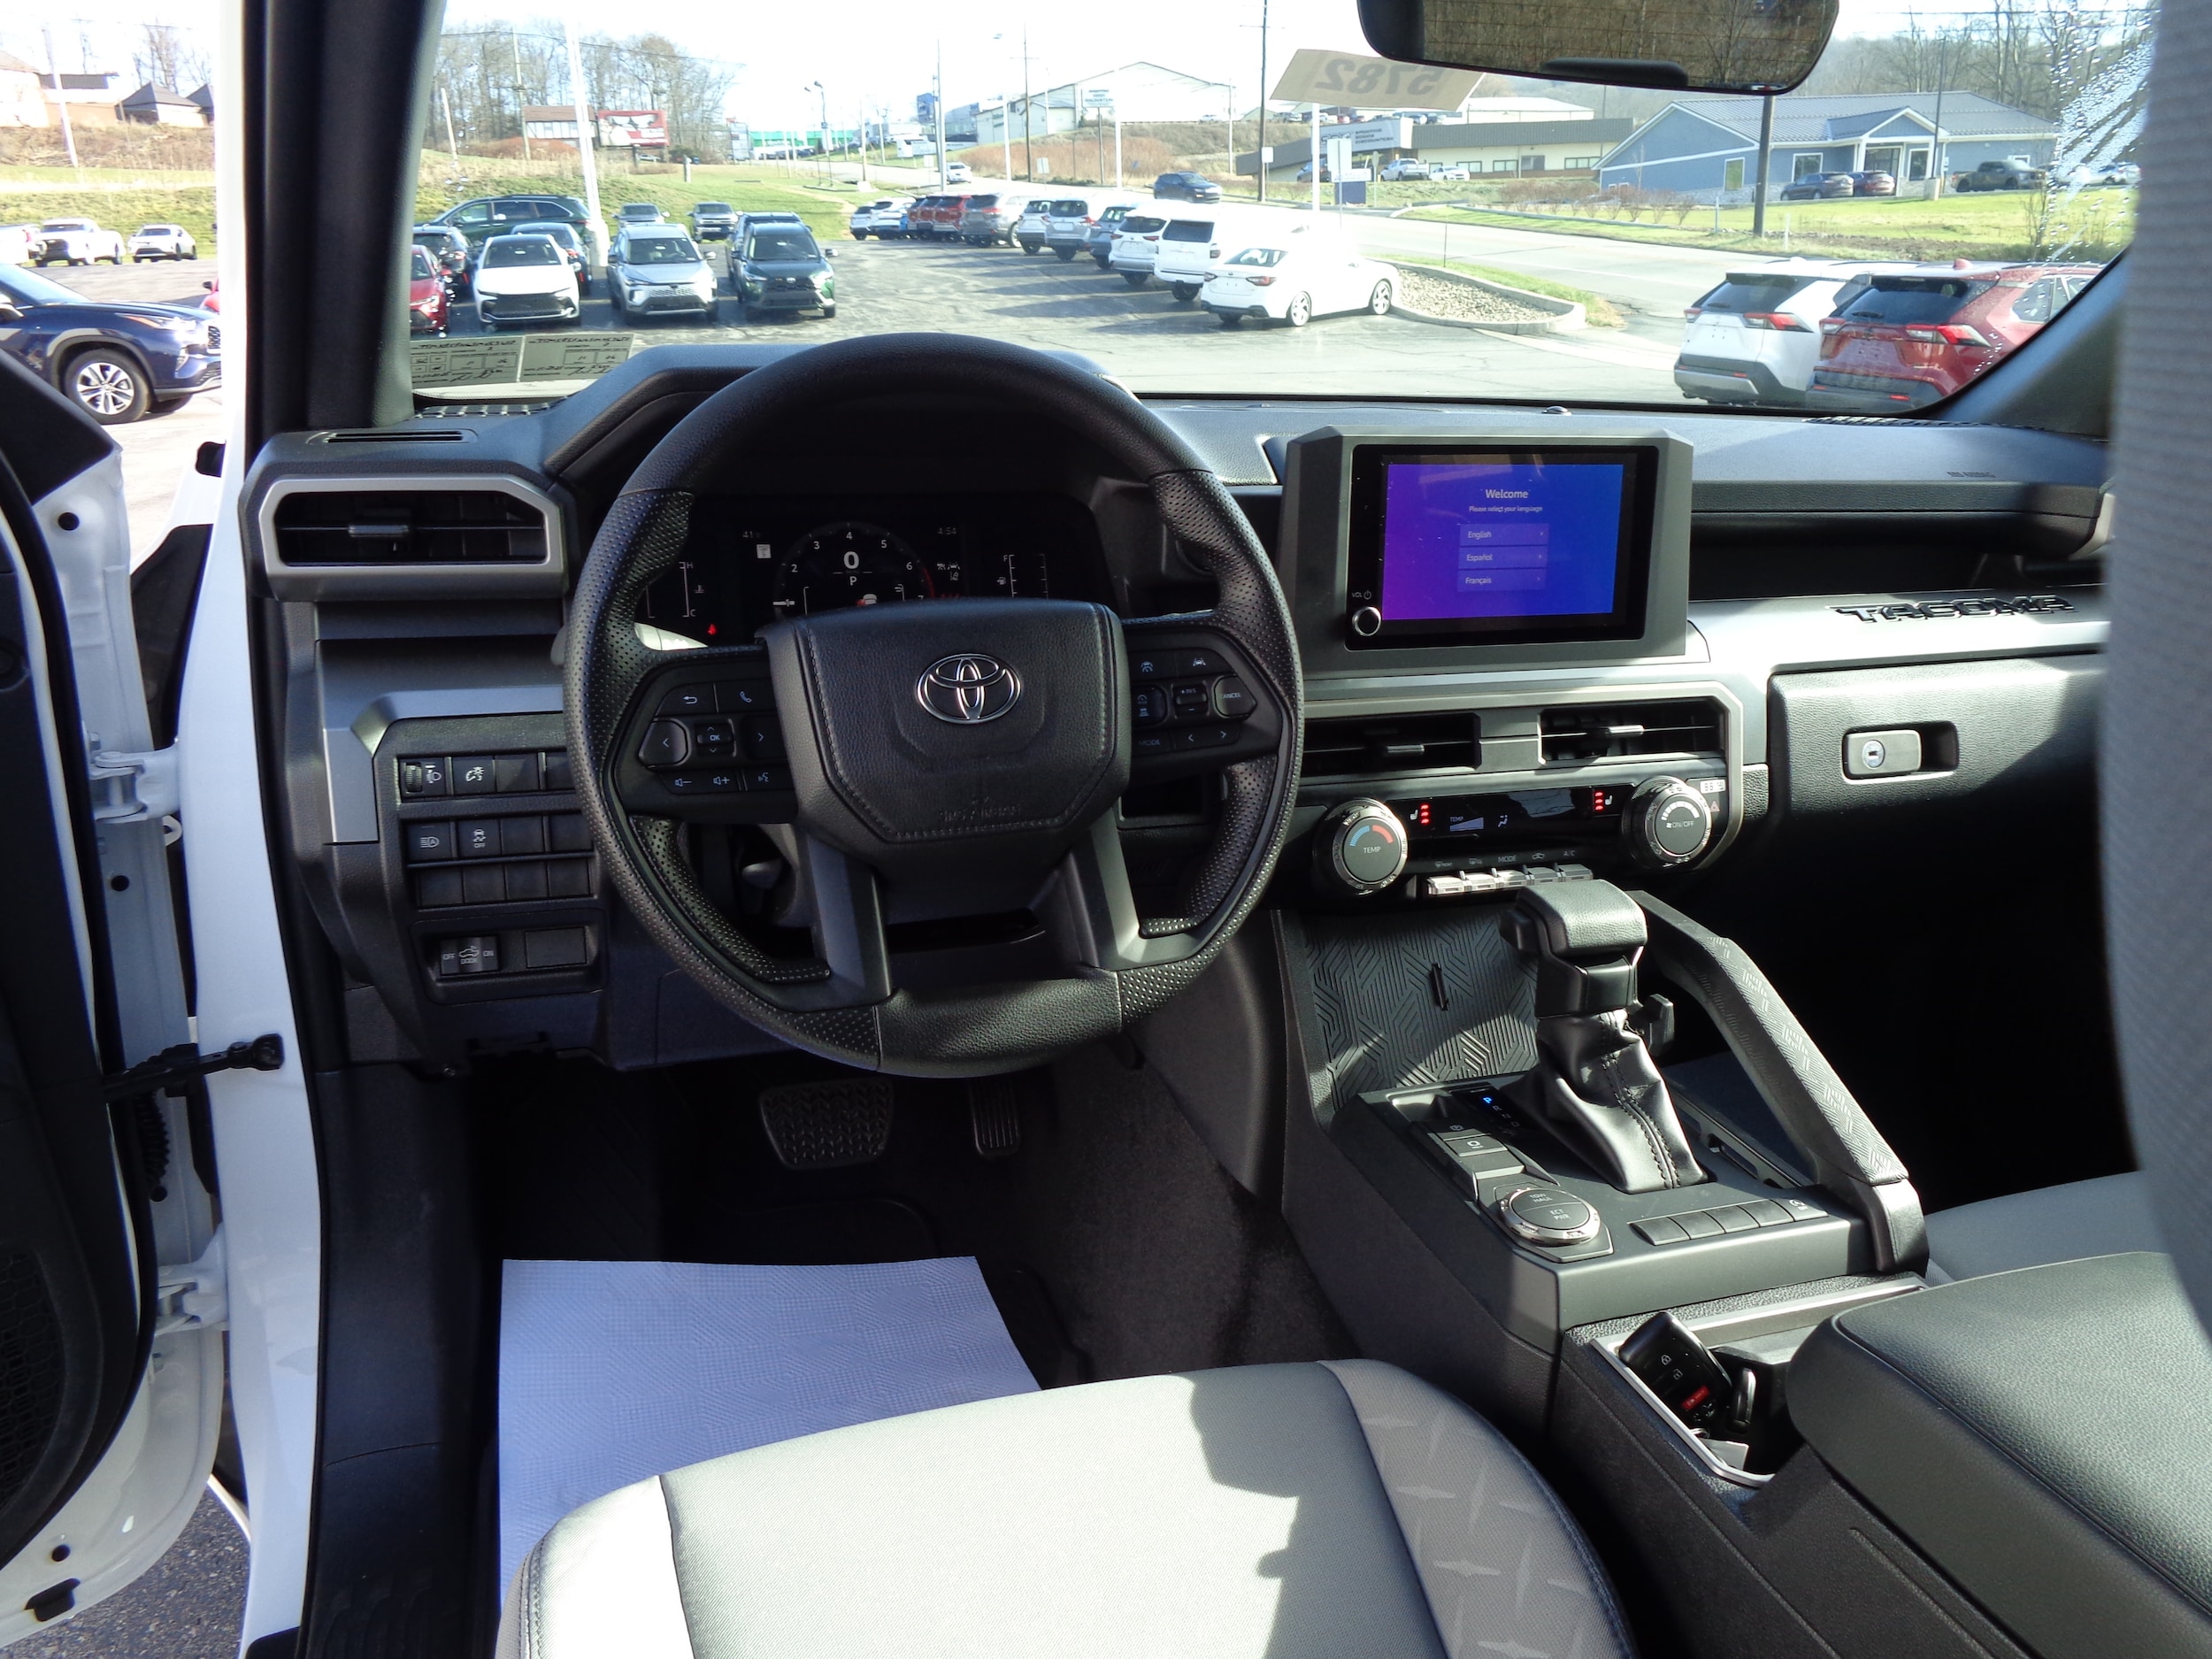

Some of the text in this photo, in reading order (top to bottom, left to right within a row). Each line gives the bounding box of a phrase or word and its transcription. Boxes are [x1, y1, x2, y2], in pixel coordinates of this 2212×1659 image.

[1486, 489, 1529, 499] Welcome
[1468, 531, 1492, 540] English
[813, 541, 820, 549] 3
[880, 540, 887, 549] 5
[843, 550, 859, 570] 0
[791, 564, 798, 573] 2
[905, 562, 912, 571] 6
[849, 576, 857, 586] P
[1825, 595, 2077, 623] TACOMA
